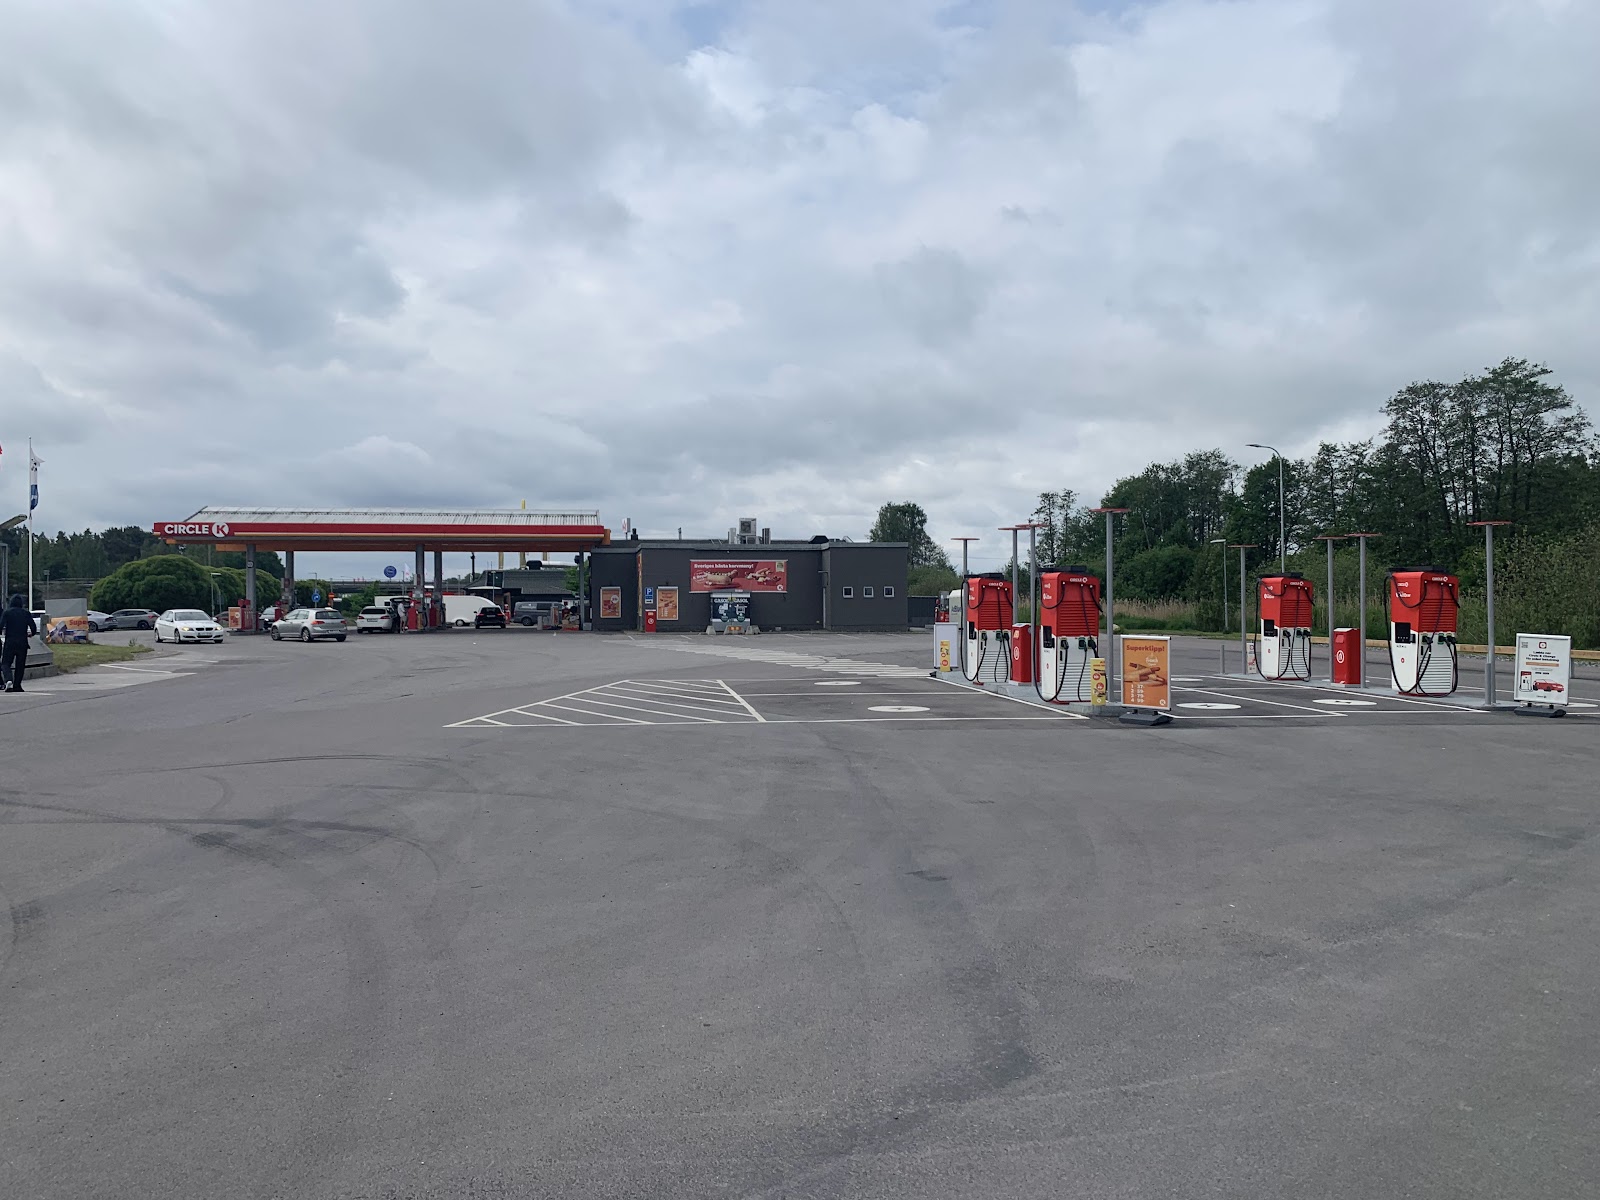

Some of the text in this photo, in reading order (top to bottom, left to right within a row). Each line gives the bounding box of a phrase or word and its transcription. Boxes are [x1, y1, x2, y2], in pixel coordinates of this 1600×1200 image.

[164, 522, 228, 537] CIRCLE K
[1126, 644, 1165, 652] Superklipp!
